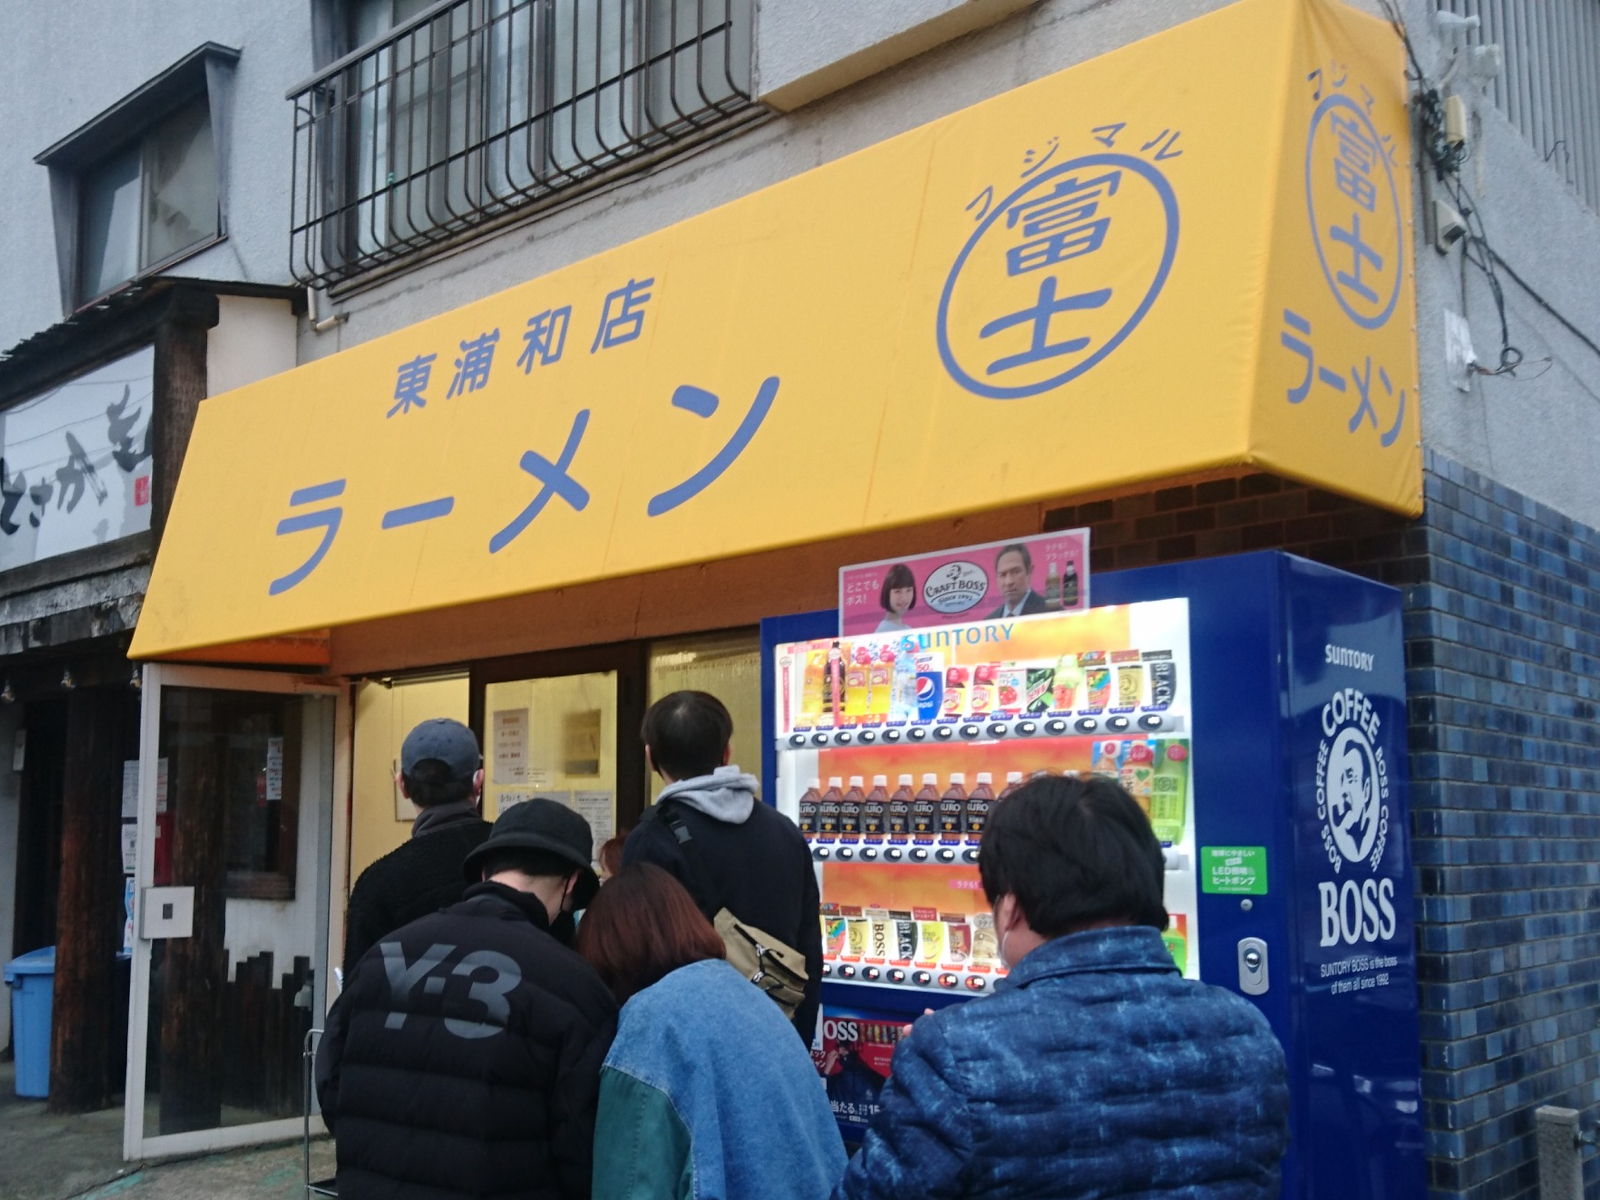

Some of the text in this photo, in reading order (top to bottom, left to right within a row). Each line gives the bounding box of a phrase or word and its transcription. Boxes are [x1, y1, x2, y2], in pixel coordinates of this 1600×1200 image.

[965, 122, 1183, 221] フジマル
[1329, 111, 1384, 305] 富士
[979, 169, 1122, 376] 富士
[387, 277, 656, 419] 東浦和店
[1280, 307, 1406, 448] ラーメン
[269, 376, 781, 596] ラーメン
[925, 579, 986, 598] CRAFT BOSS
[1153, 661, 1173, 706] BLACK
[1321, 687, 1381, 746] COFFEE
[1315, 738, 1330, 820] COFFEE
[873, 922, 886, 957] BOSS
[897, 920, 914, 960] BLACK
[1318, 877, 1397, 948] BOSS
[379, 941, 522, 1040] Y-3
[1320, 959, 1351, 978] SUNTORY
[1351, 957, 1369, 973] BOSS
[1375, 956, 1384, 969] the
[1384, 955, 1398, 967] boss
[1338, 980, 1352, 993] them
[1361, 977, 1375, 990] since
[1376, 972, 1389, 986] 1992
[823, 1020, 859, 1041] OSS
